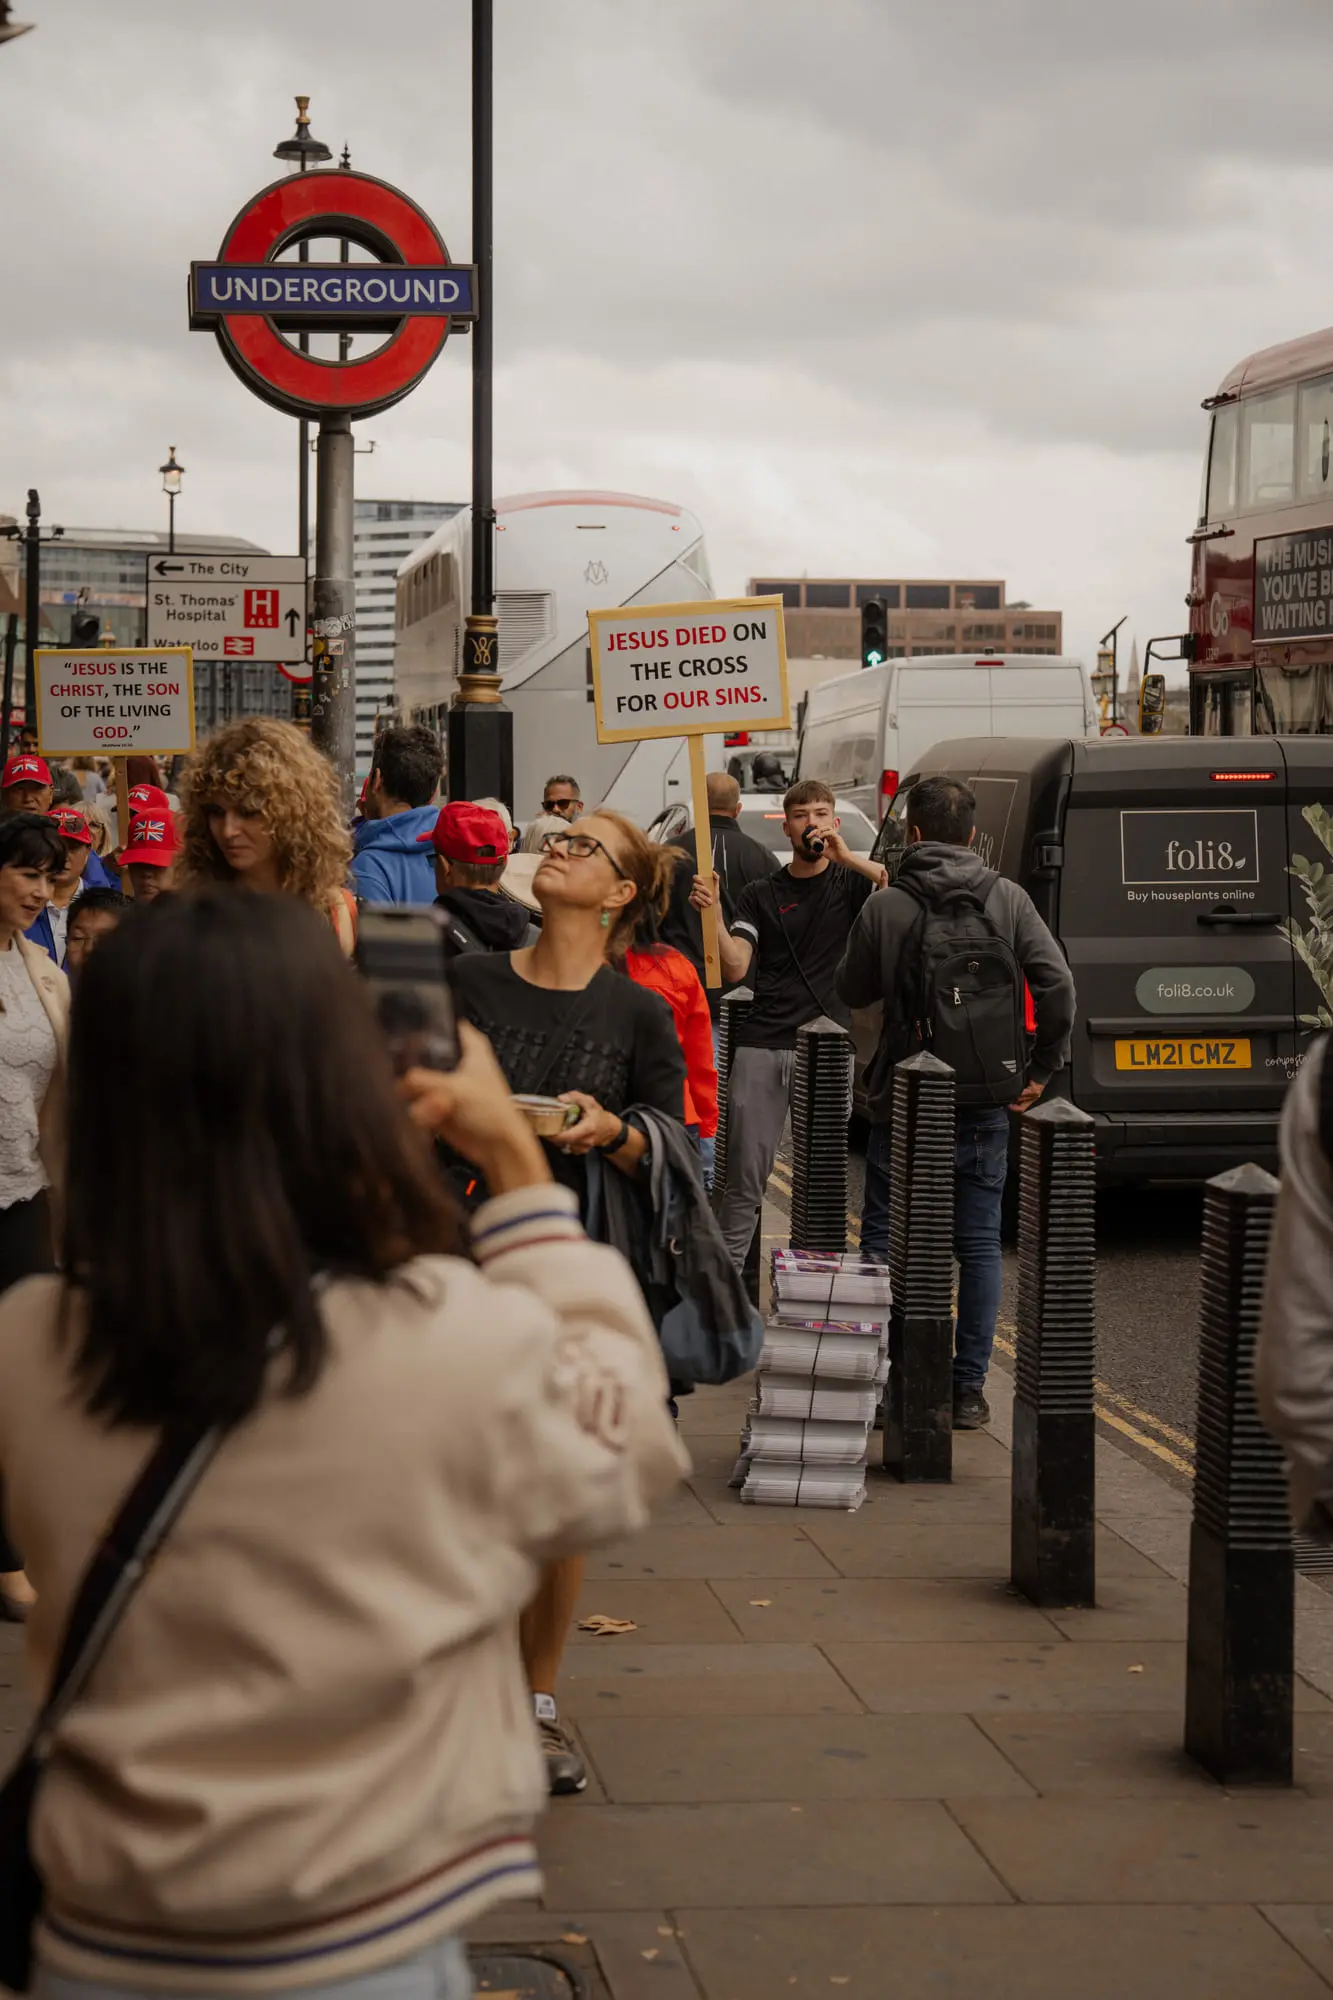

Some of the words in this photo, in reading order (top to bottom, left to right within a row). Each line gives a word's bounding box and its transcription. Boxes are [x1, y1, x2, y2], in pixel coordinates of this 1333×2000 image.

[210, 277, 460, 304] UNDERGROUND
[1263, 544, 1291, 573] THE
[1293, 538, 1333, 569] MUSI
[188, 562, 215, 575] The
[219, 562, 249, 577] City
[1262, 571, 1317, 602] YOU'VE
[1320, 569, 1333, 597] B
[154, 593, 175, 606] St.
[180, 593, 239, 607] Thomas'
[251, 590, 272, 616] H
[166, 608, 226, 623] Hospital
[1209, 591, 1229, 638] Go
[1261, 600, 1327, 631] WAITING
[154, 638, 219, 651] Waterloo
[607, 629, 669, 651] JESUS
[675, 625, 727, 646] DIED
[733, 622, 767, 642] ON
[64, 662, 117, 676] “JESUS
[121, 662, 135, 675] IS
[137, 662, 168, 675] THE
[630, 661, 672, 681] THE
[678, 655, 748, 677] CROSS
[50, 683, 109, 699] CHRIST,
[112, 684, 143, 696] THE
[147, 683, 180, 696] SON
[616, 694, 658, 713] FOR
[663, 690, 710, 709] OUR
[715, 685, 768, 706] SINS.
[60, 705, 81, 718] OF
[85, 705, 115, 718] THE
[119, 704, 171, 717] LIVING
[1164, 840, 1234, 871] foli8
[1127, 890, 1149, 903] Buy
[1151, 889, 1220, 902] houseplants
[1222, 889, 1256, 901] online
[1156, 983, 1235, 998] foli8.co.uk
[1130, 1043, 1183, 1066] LM21
[1190, 1042, 1237, 1065] CMZ
